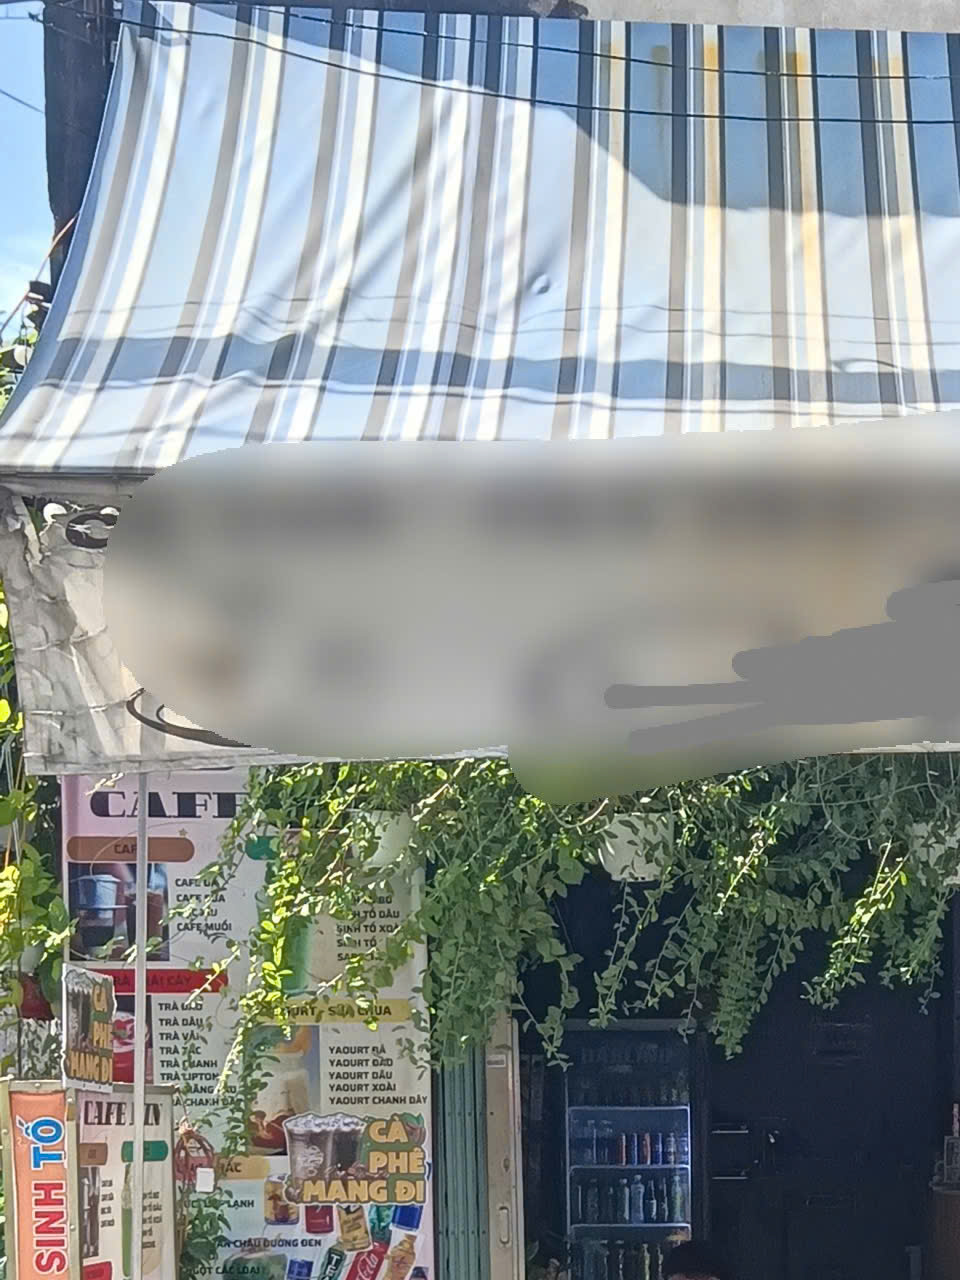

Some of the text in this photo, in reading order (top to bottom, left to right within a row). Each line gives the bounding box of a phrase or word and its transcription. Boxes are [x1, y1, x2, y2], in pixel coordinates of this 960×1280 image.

[114, 844, 138, 854] CAF
[158, 1001, 180, 1011] TRÀ
[158, 1015, 180, 1026] TRÀ
[159, 1030, 180, 1041] TRÀ
[159, 1044, 180, 1055] TRÀ
[329, 1045, 370, 1055] YAOURT
[160, 1058, 181, 1069] TRÀ
[329, 1058, 370, 1068] YAOURT
[160, 1071, 181, 1081] TRÀ
[329, 1071, 370, 1080] YAOURT
[329, 1083, 370, 1093] YAOURT
[329, 1096, 370, 1105] YAOURT
[371, 1096, 407, 1105] CHANH
[369, 1114, 409, 1143] CÀ
[16, 1115, 67, 1171] TỐ
[369, 1146, 425, 1174] PHÊ
[303, 1179, 425, 1202] MANG ĐI
[33, 1180, 68, 1275] SINH
